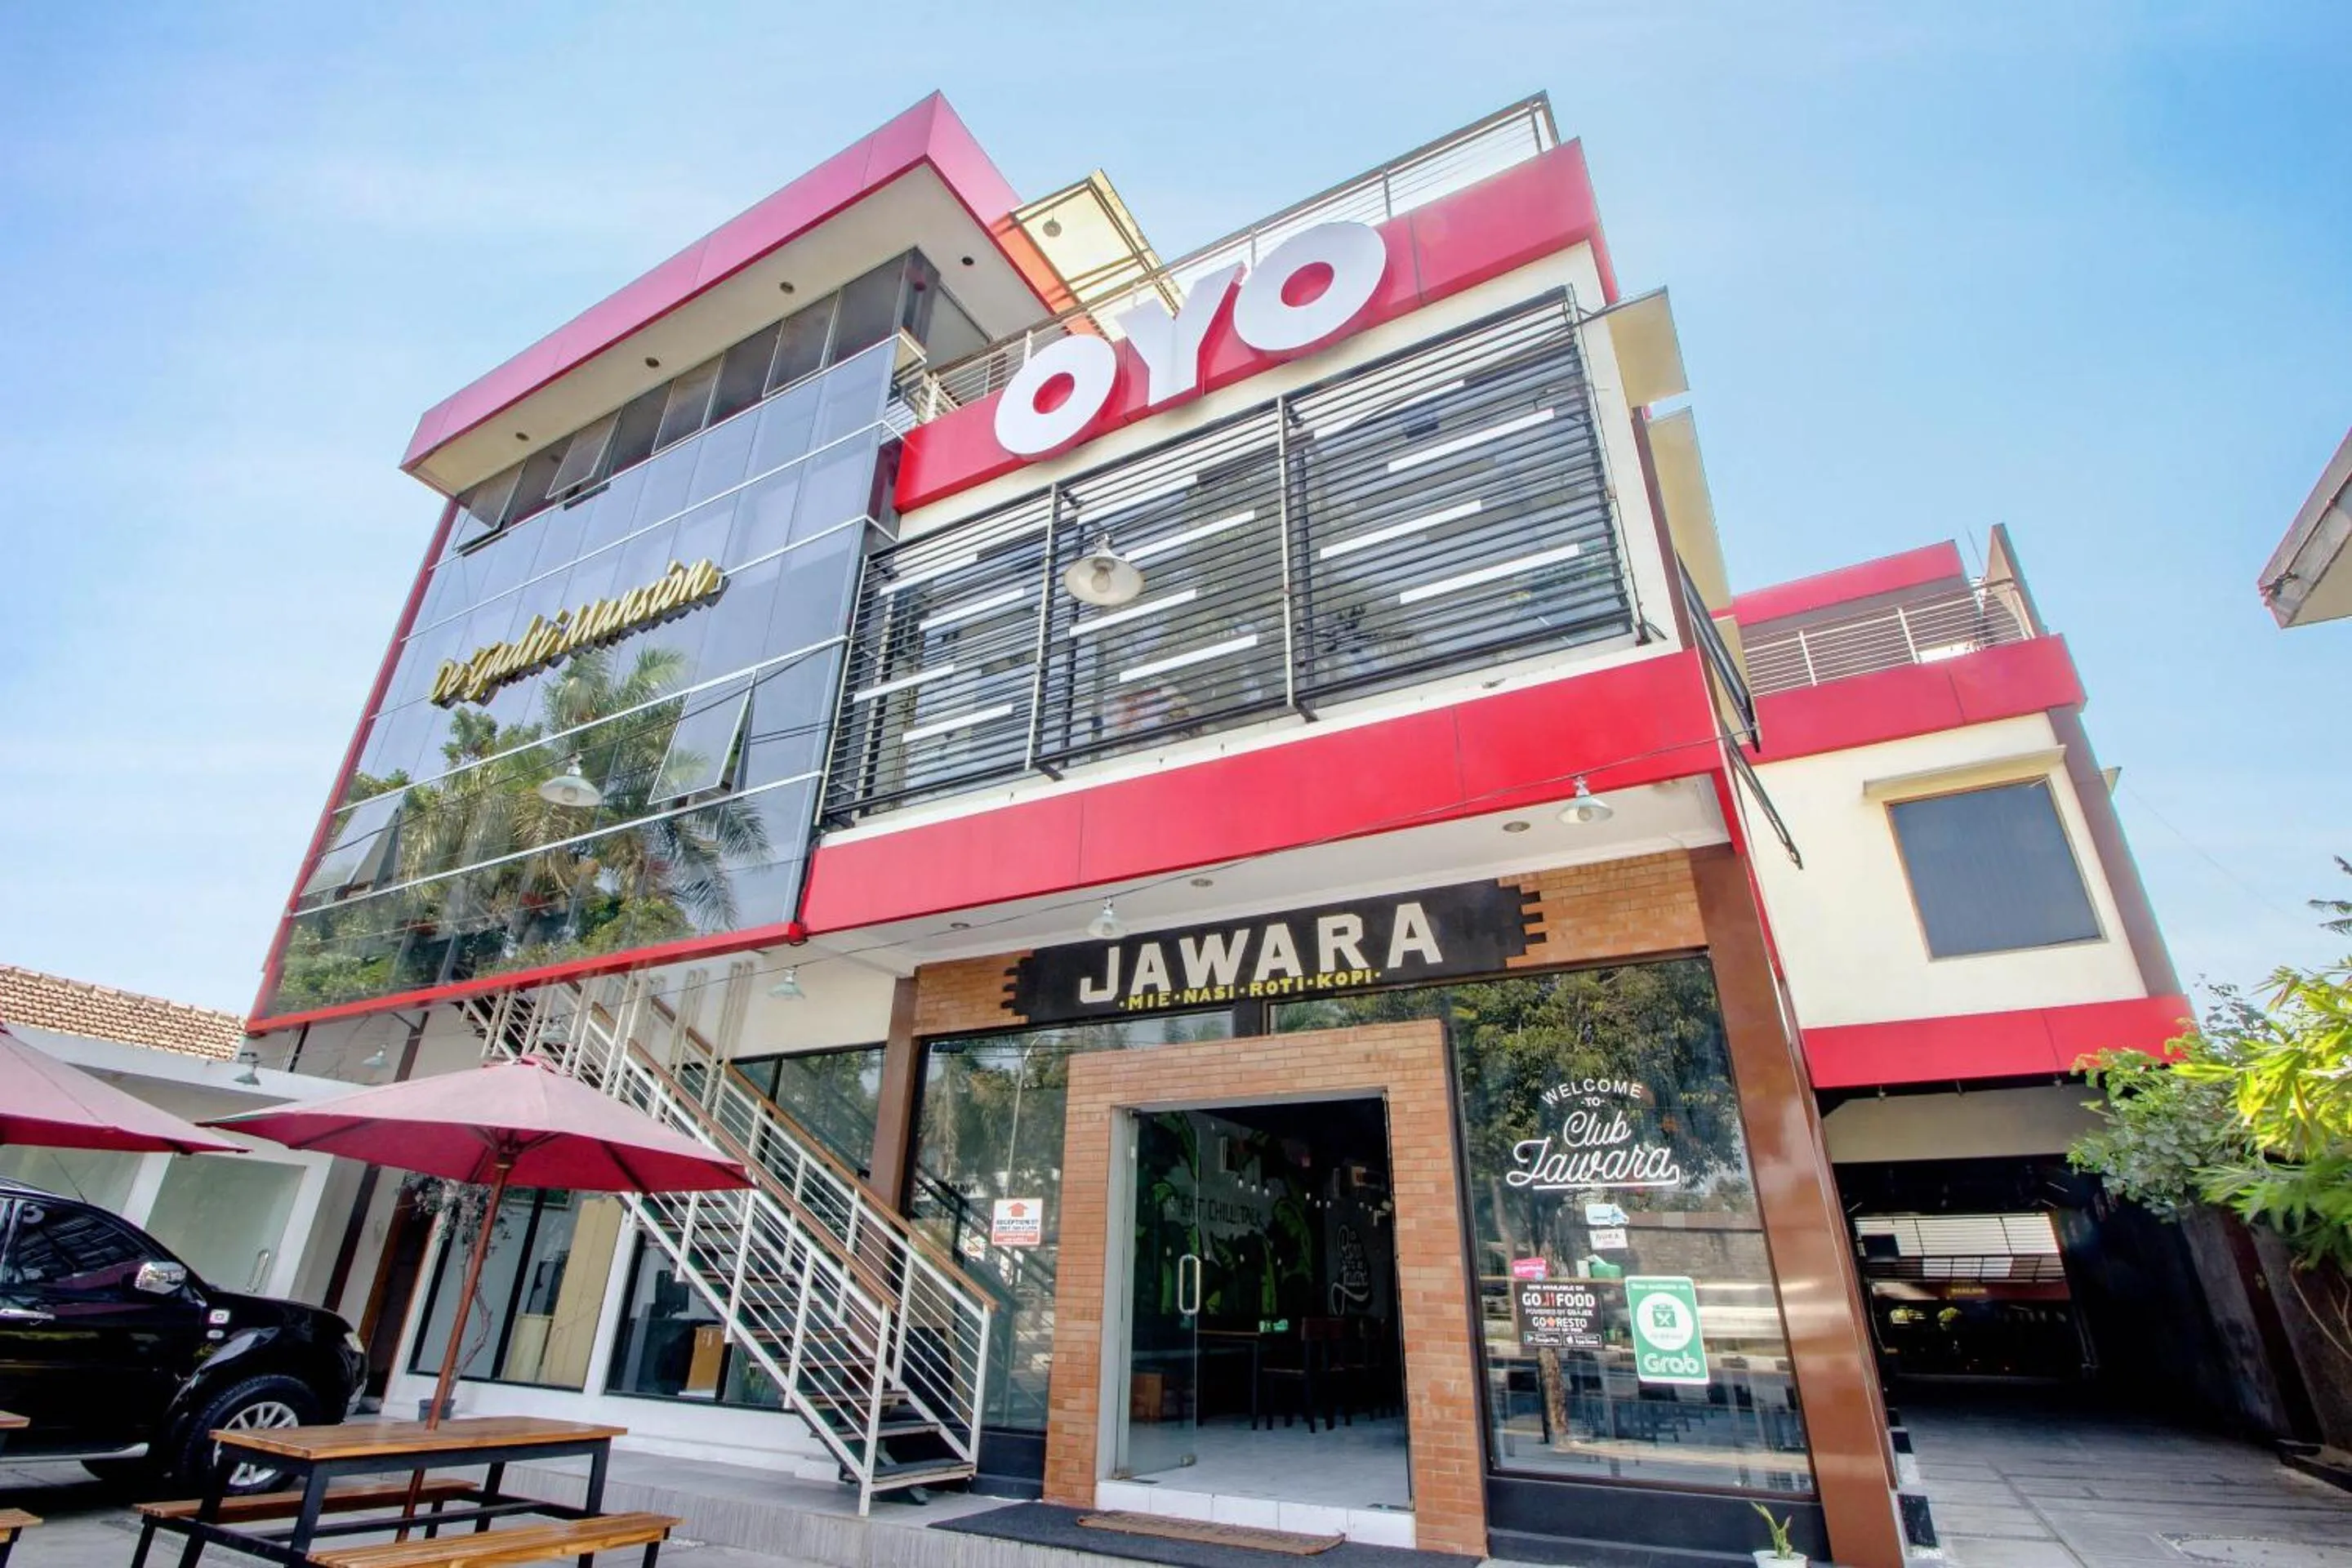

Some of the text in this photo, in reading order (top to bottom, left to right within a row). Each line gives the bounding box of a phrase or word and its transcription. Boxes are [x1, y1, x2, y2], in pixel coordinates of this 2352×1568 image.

[994, 220, 1388, 457] OYO
[557, 558, 728, 653] Mansion
[1079, 902, 1443, 1004] JAWARA
[1540, 1078, 1643, 1105] WELCOME
[1563, 1110, 1632, 1147] Club
[1506, 1136, 1681, 1189] Jawara
[1556, 1293, 1595, 1307] FOOD
[1557, 1316, 1588, 1328] RESTO
[1643, 1351, 1700, 1375] Grab
